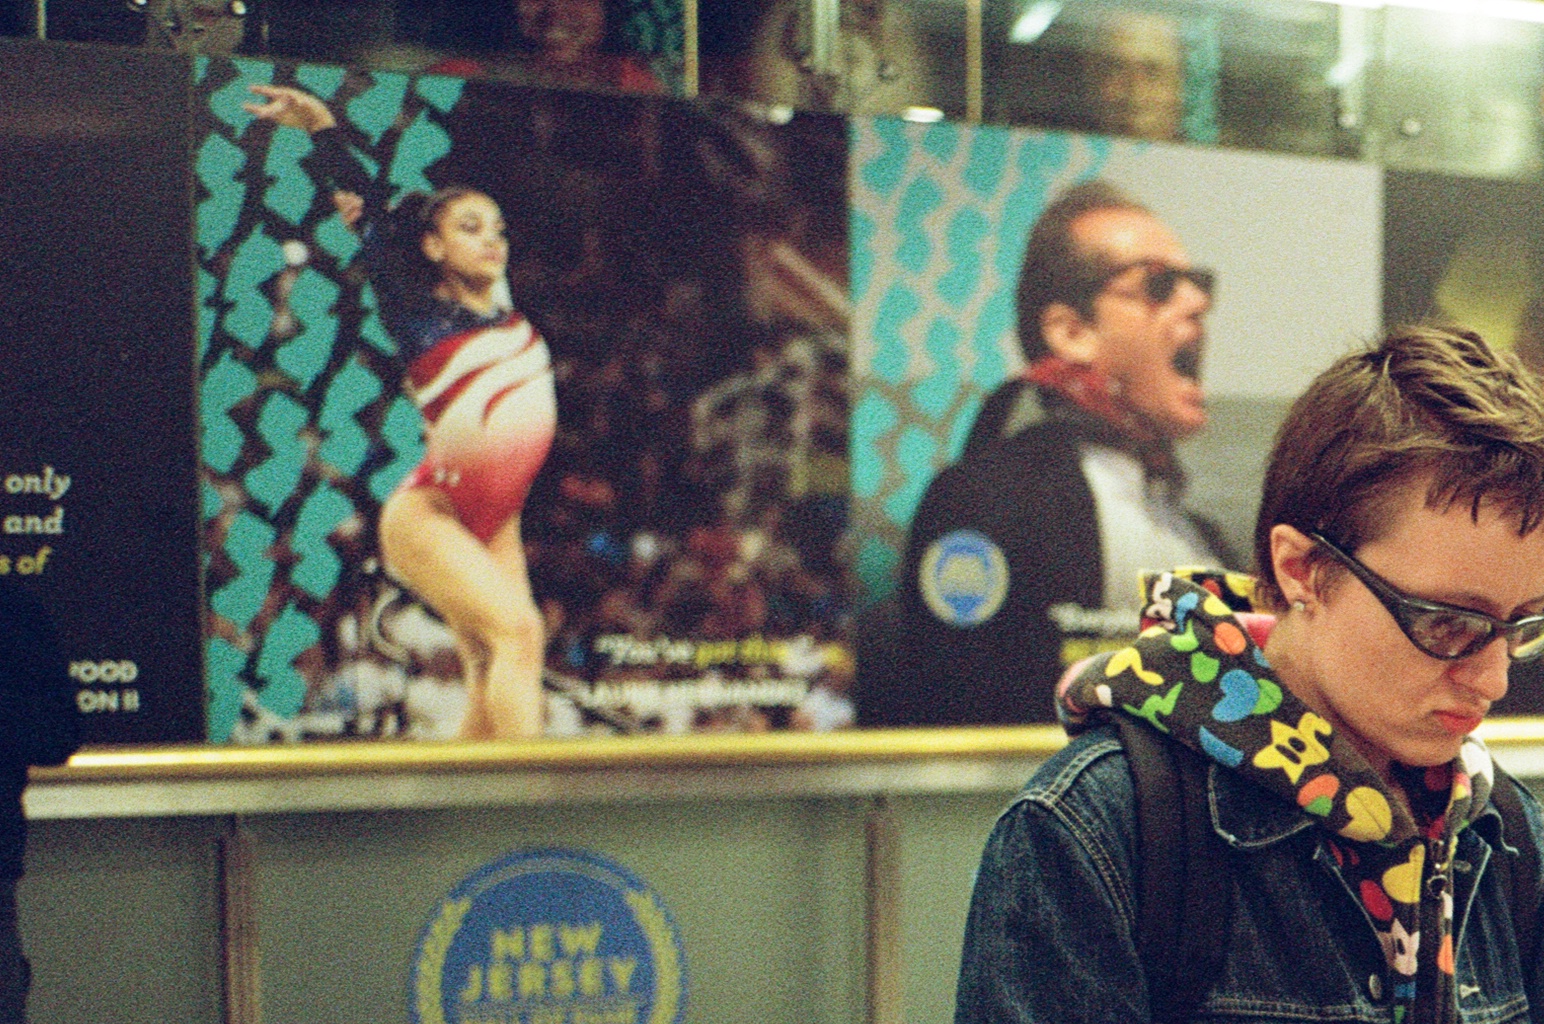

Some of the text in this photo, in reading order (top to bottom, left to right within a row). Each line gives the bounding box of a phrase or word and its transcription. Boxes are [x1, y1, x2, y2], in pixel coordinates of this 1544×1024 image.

[5, 465, 71, 500] only
[3, 506, 63, 534] and
[16, 545, 52, 575] of
[491, 922, 602, 960] NEW
[459, 955, 638, 1002] JERSEY
